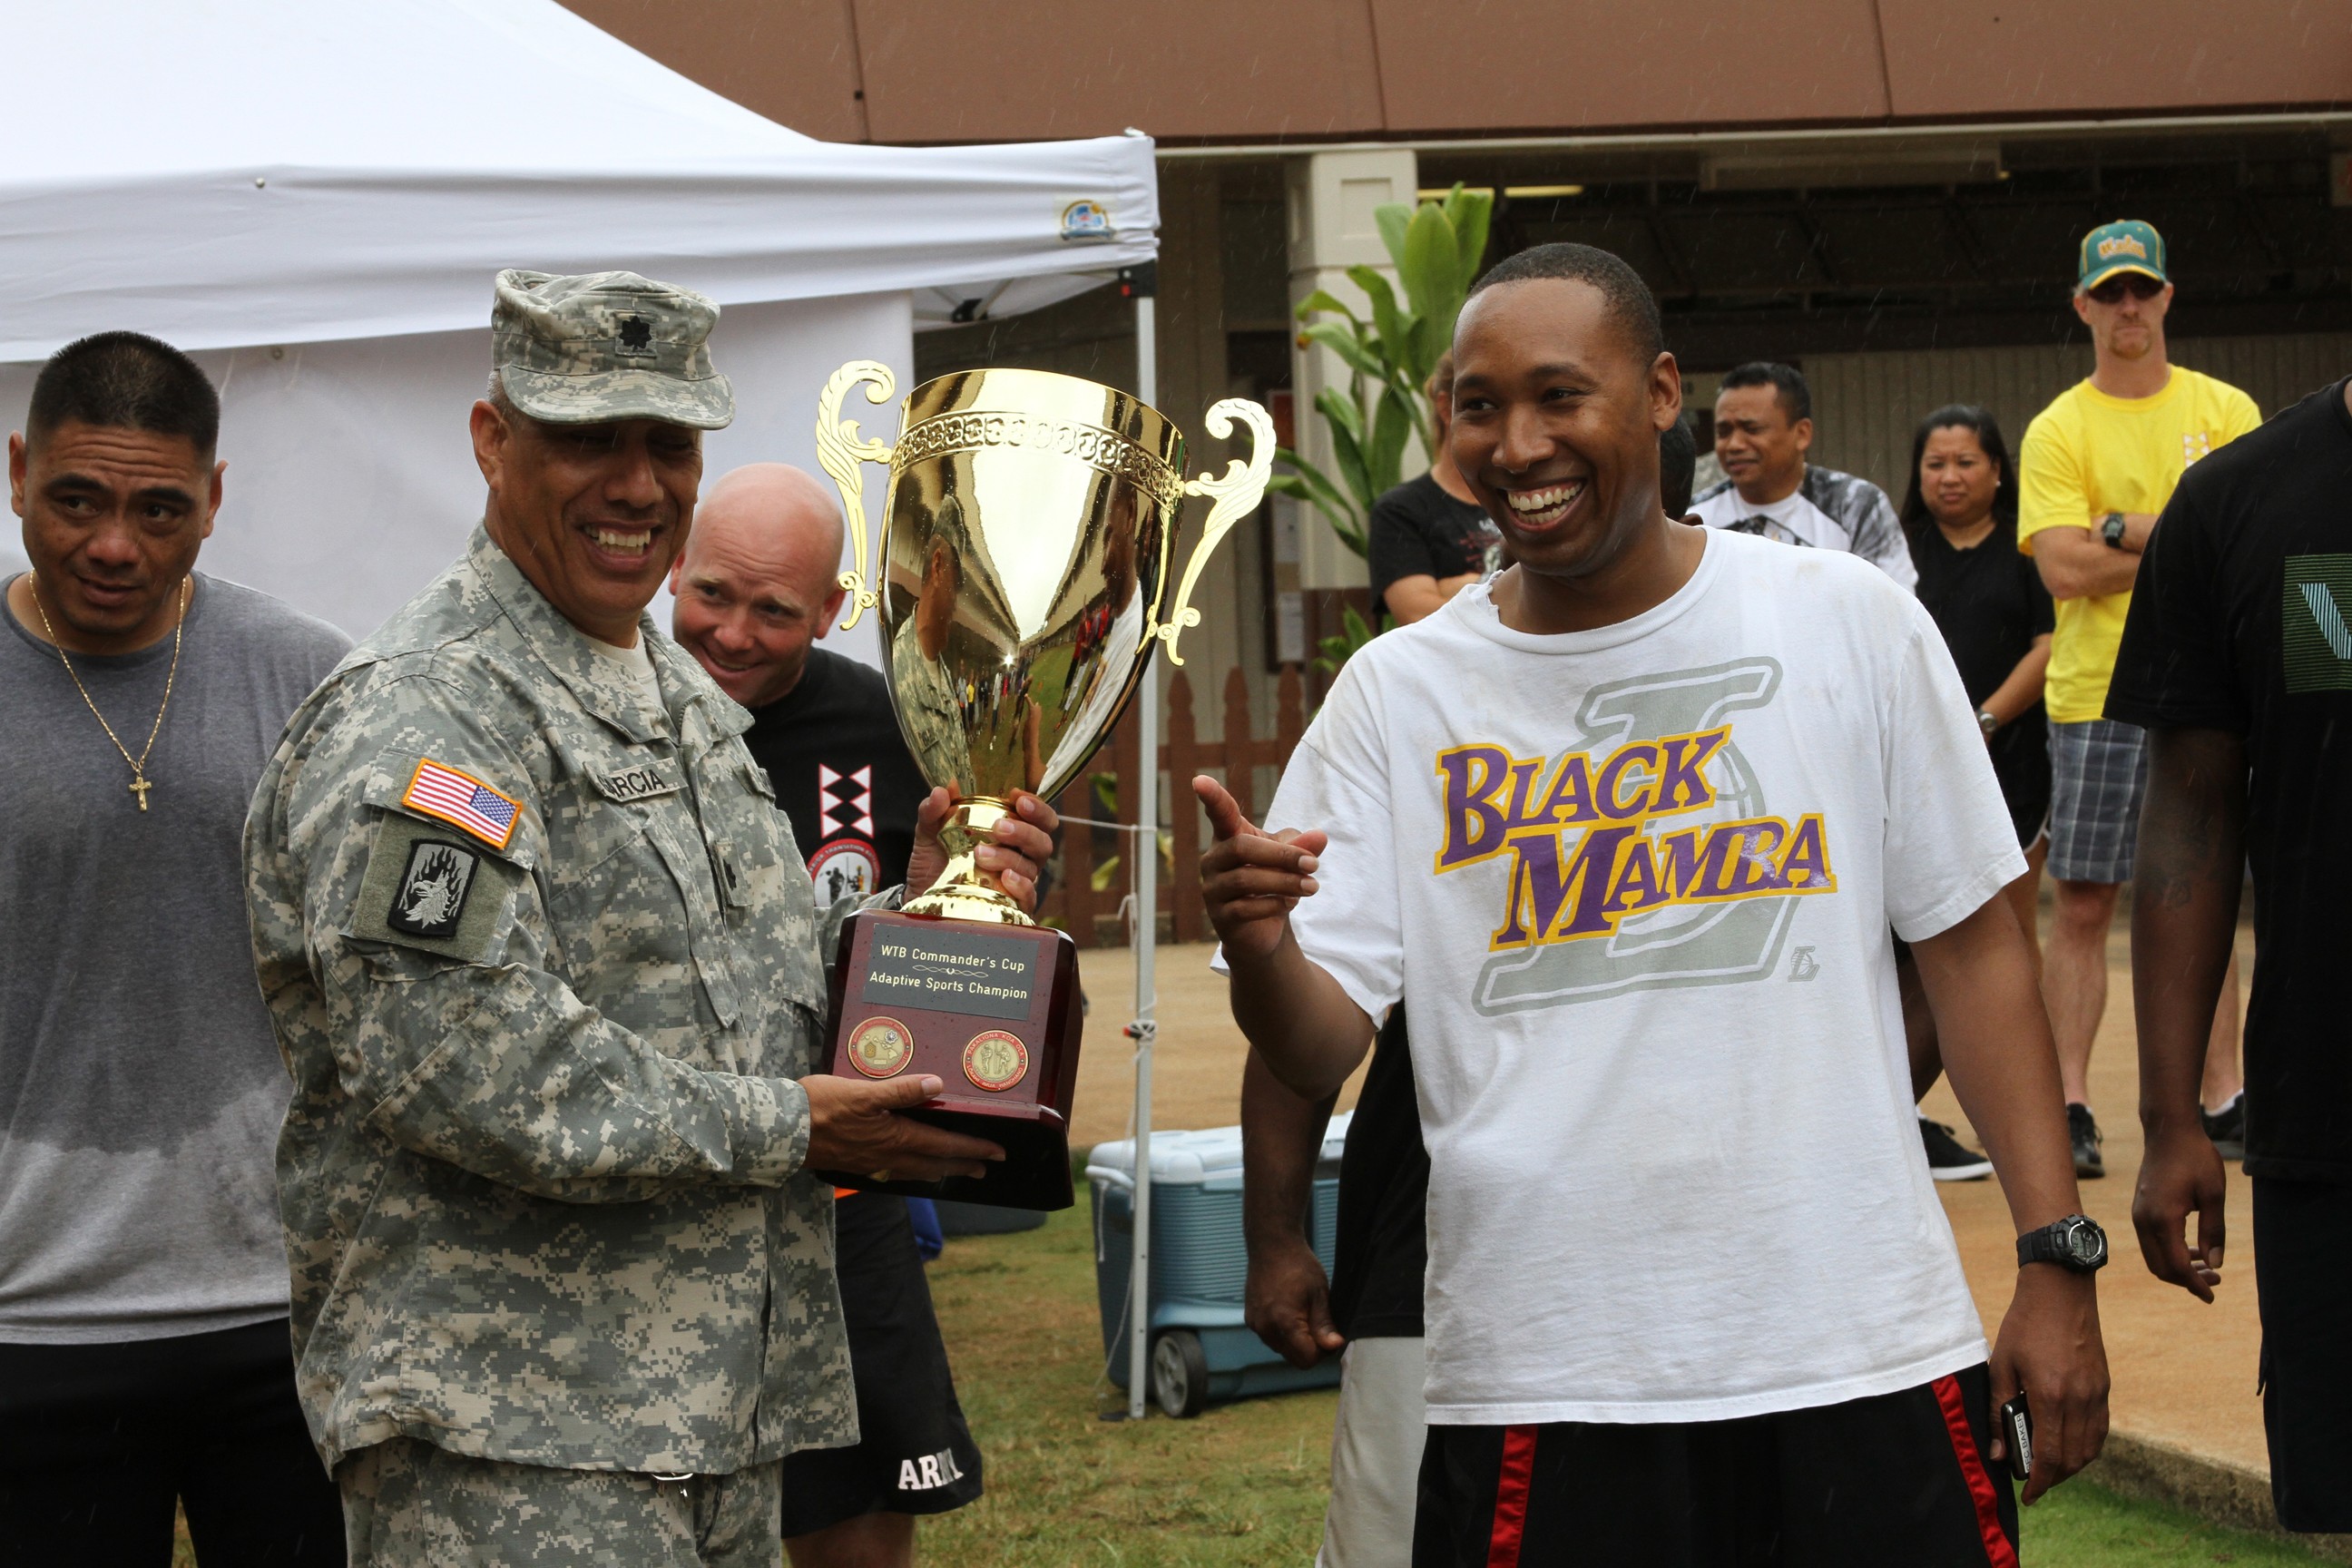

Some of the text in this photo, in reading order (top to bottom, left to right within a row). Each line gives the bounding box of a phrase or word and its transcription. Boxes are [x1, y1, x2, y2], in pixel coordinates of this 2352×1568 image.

[1434, 723, 1732, 876] BLACK
[1489, 812, 1838, 952] MAMBA
[881, 945, 1024, 972] WTB Commander's Cup
[869, 971, 1027, 999] Adaptive Sports Champion
[967, 1033, 998, 1054] PAKALIONA
[1002, 1034, 1014, 1044] KOA
[2015, 1415, 2028, 1448] BAKER
